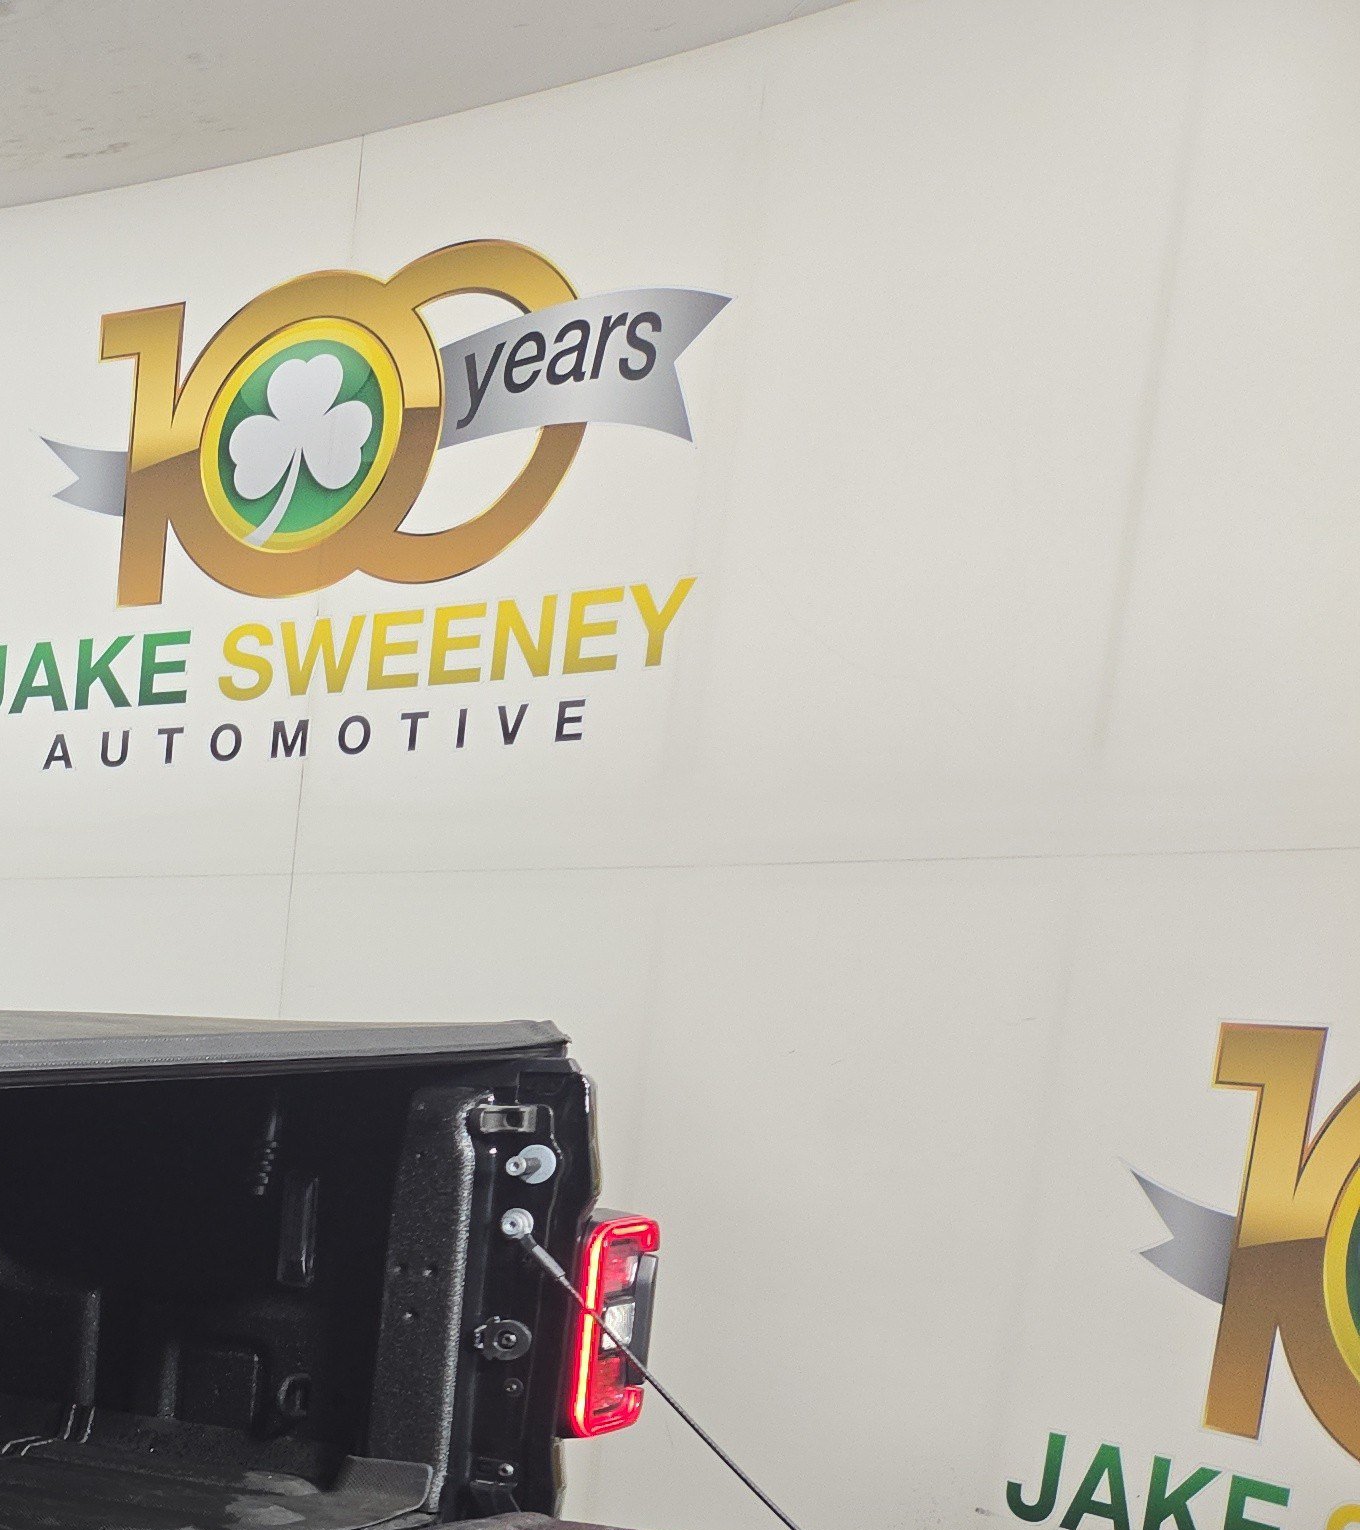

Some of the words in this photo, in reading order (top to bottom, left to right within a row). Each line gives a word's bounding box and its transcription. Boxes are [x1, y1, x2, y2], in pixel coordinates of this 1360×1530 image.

[99, 238, 587, 607] 100
[456, 310, 662, 430] years
[217, 576, 698, 702] SWEENEY
[41, 698, 586, 771] AUTOMOTIVE
